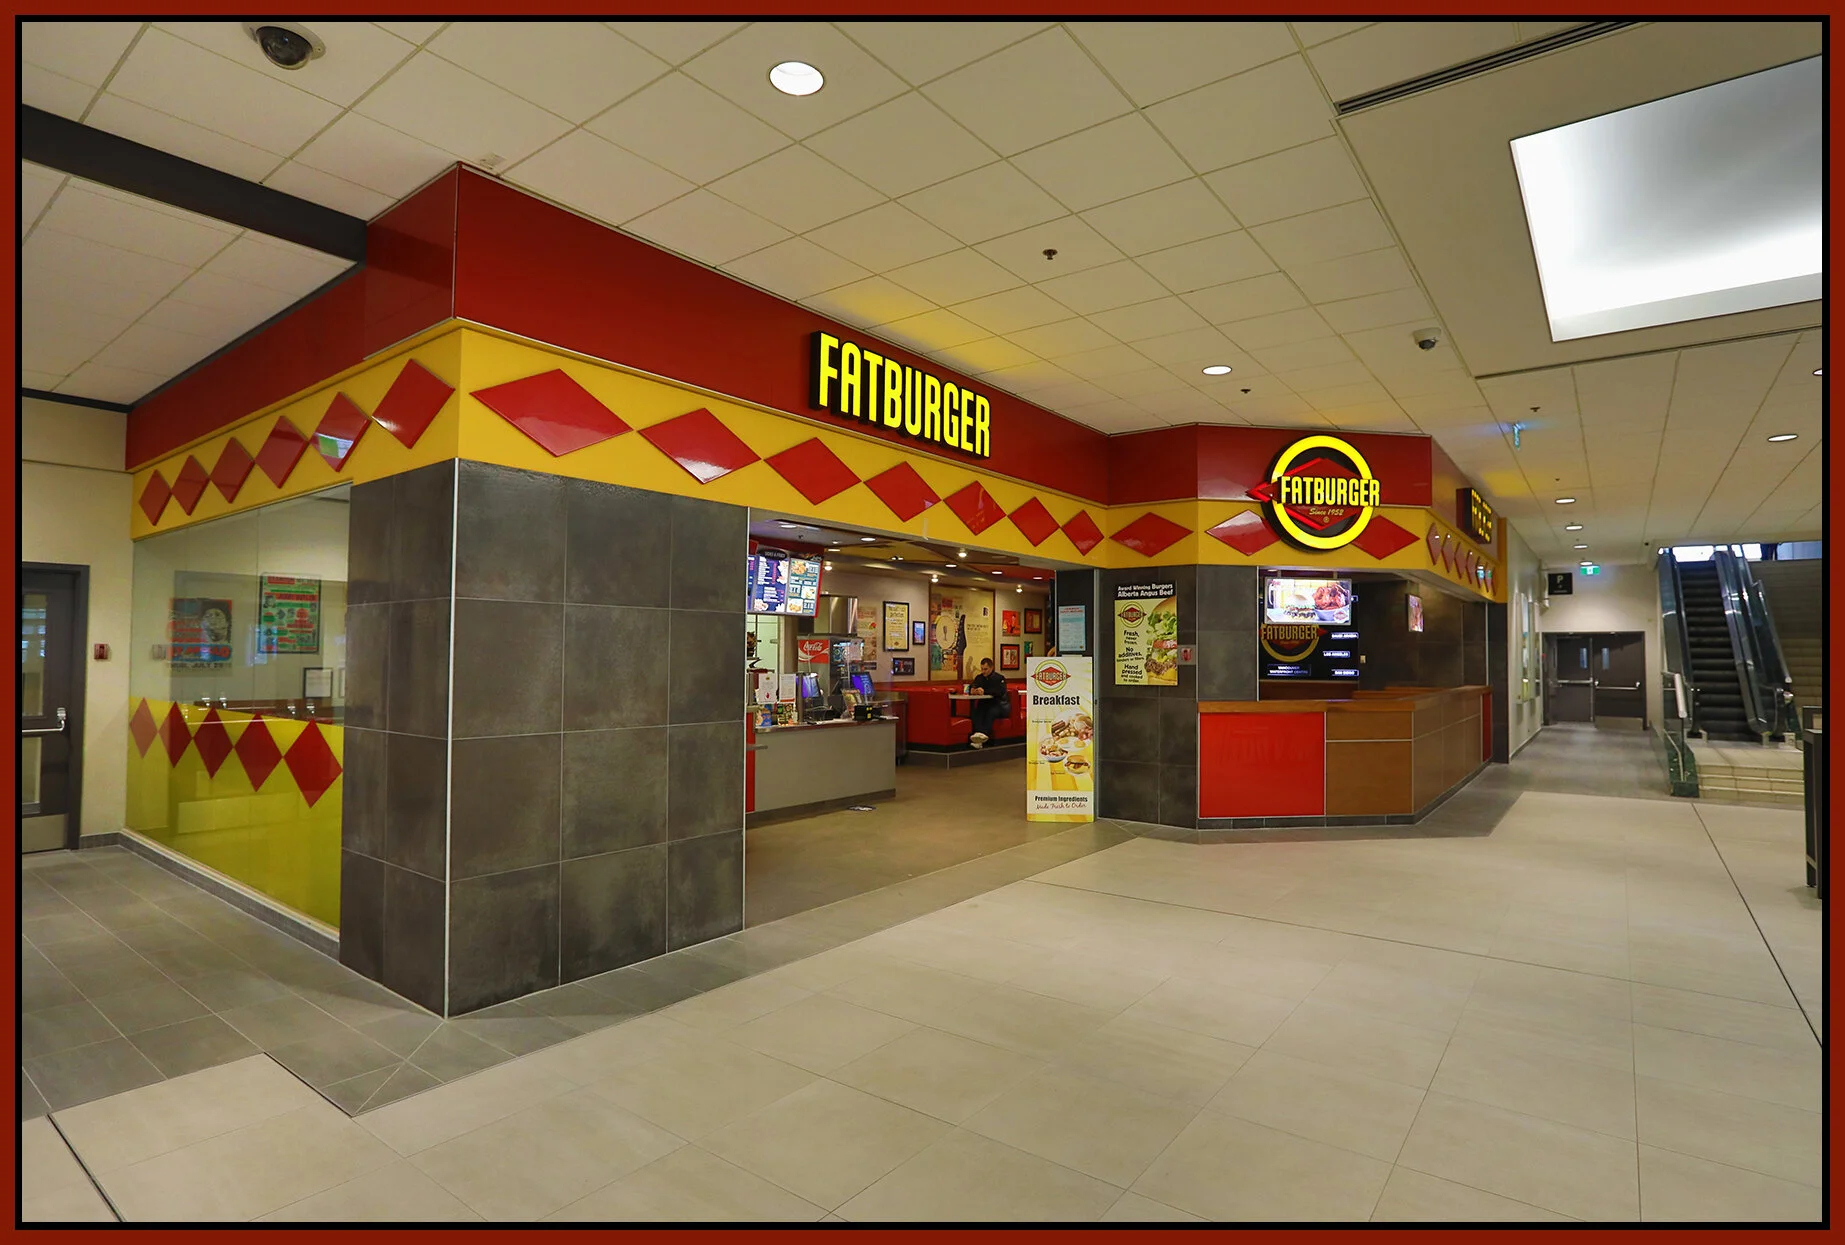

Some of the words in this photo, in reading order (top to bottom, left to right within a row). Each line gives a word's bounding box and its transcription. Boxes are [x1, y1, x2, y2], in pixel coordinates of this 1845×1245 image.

[819, 332, 991, 458] FATBURGER
[1281, 475, 1381, 507] FATBURGER
[1308, 507, 1327, 516] Since
[1327, 508, 1345, 516] 1952
[1151, 583, 1173, 591] Burgers
[1123, 630, 1140, 638] Fresh,
[1261, 625, 1318, 640] FATBURGER
[1035, 672, 1067, 681] FATBURGER
[1032, 695, 1081, 706] Breakfast
[1058, 795, 1088, 803] Ingredients
